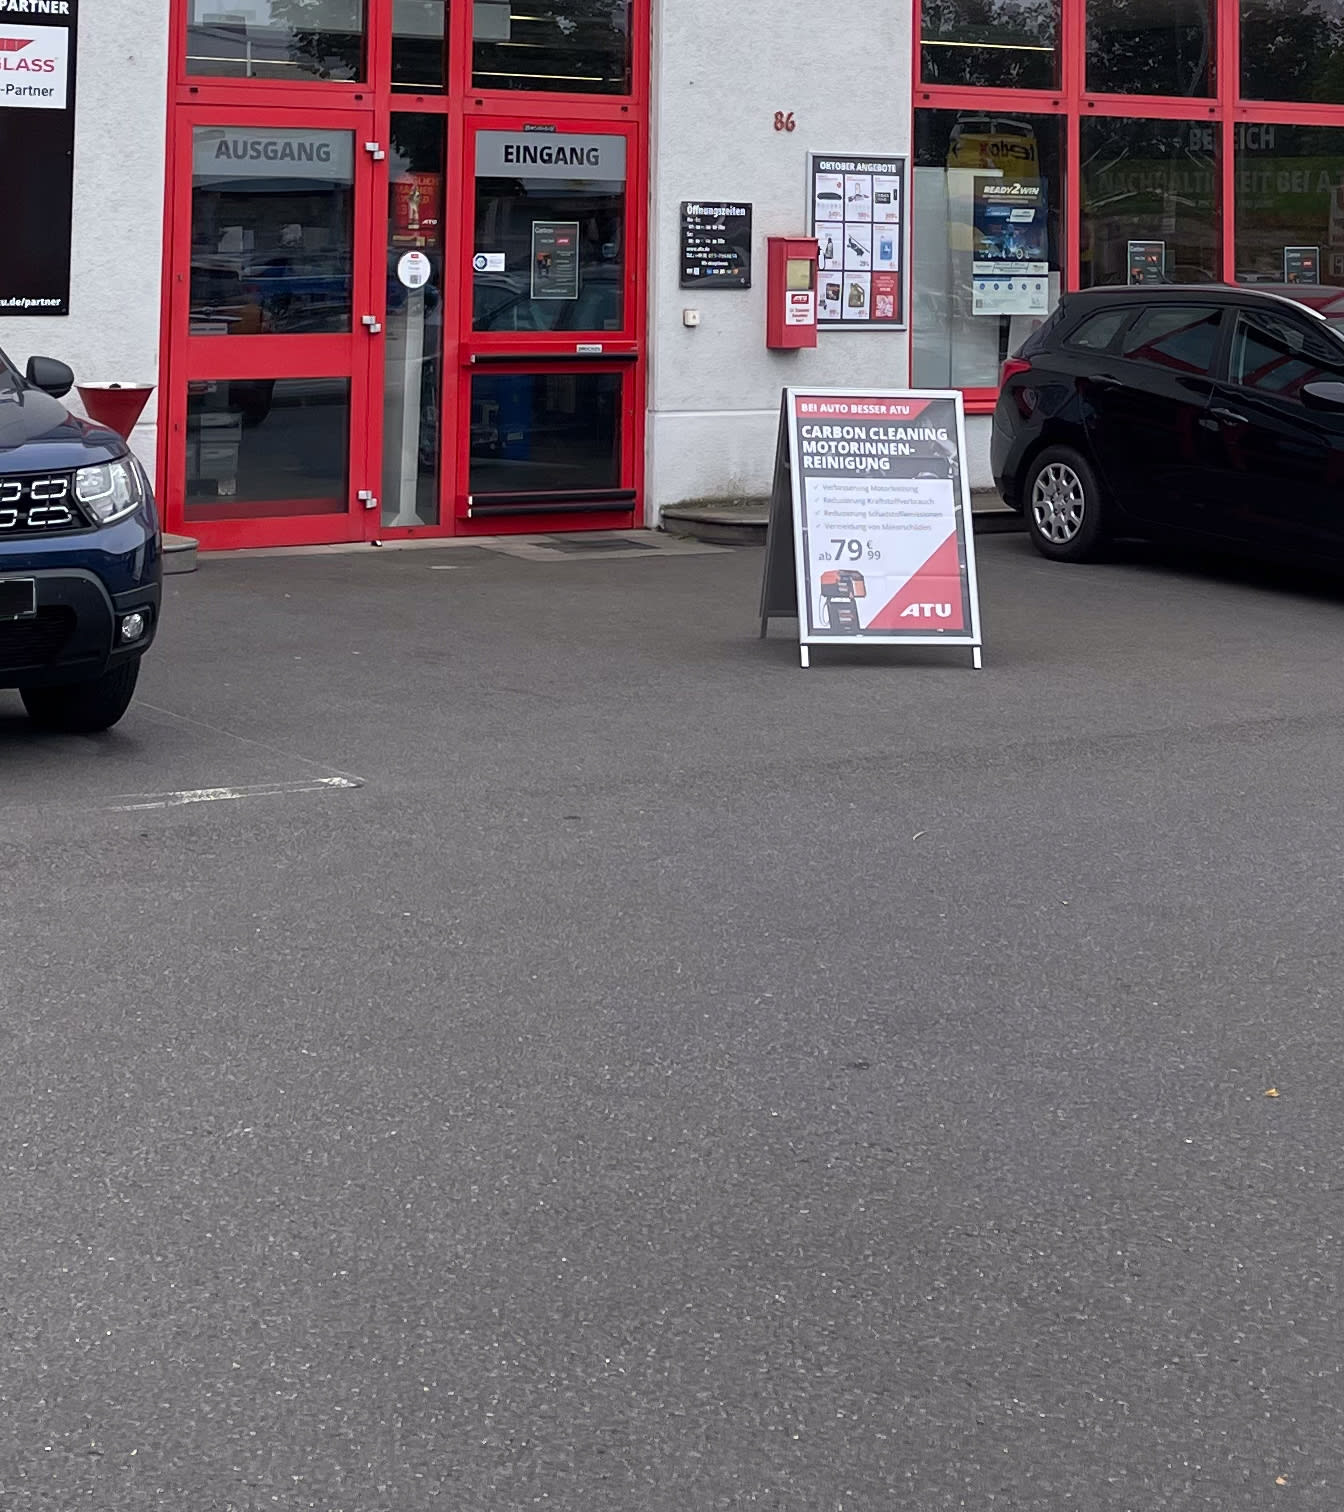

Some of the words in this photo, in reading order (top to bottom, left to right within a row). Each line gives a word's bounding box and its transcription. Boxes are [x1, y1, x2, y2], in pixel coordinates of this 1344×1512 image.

[773, 111, 796, 133] 86
[1189, 126, 1275, 152] BEICH
[215, 139, 331, 163] AUSGANG
[503, 144, 600, 167] EINGANG
[819, 161, 855, 171] OKTOBER
[856, 162, 897, 173] ANGEBOTE
[983, 183, 1040, 196] READY2WIN
[687, 203, 746, 218] Öffnungszeiten
[801, 403, 818, 412] BEI
[820, 404, 848, 413] AUTO
[850, 404, 887, 414] BESSER
[889, 405, 910, 415] ATU
[801, 425, 867, 439] CARBON
[869, 427, 948, 441] CLEANING
[802, 441, 915, 456] MOTORINNEN-
[803, 455, 891, 470] REINIGUNG
[818, 551, 832, 561] ab
[831, 538, 863, 561] 79
[867, 550, 881, 560] 99
[900, 603, 952, 618] ATU
